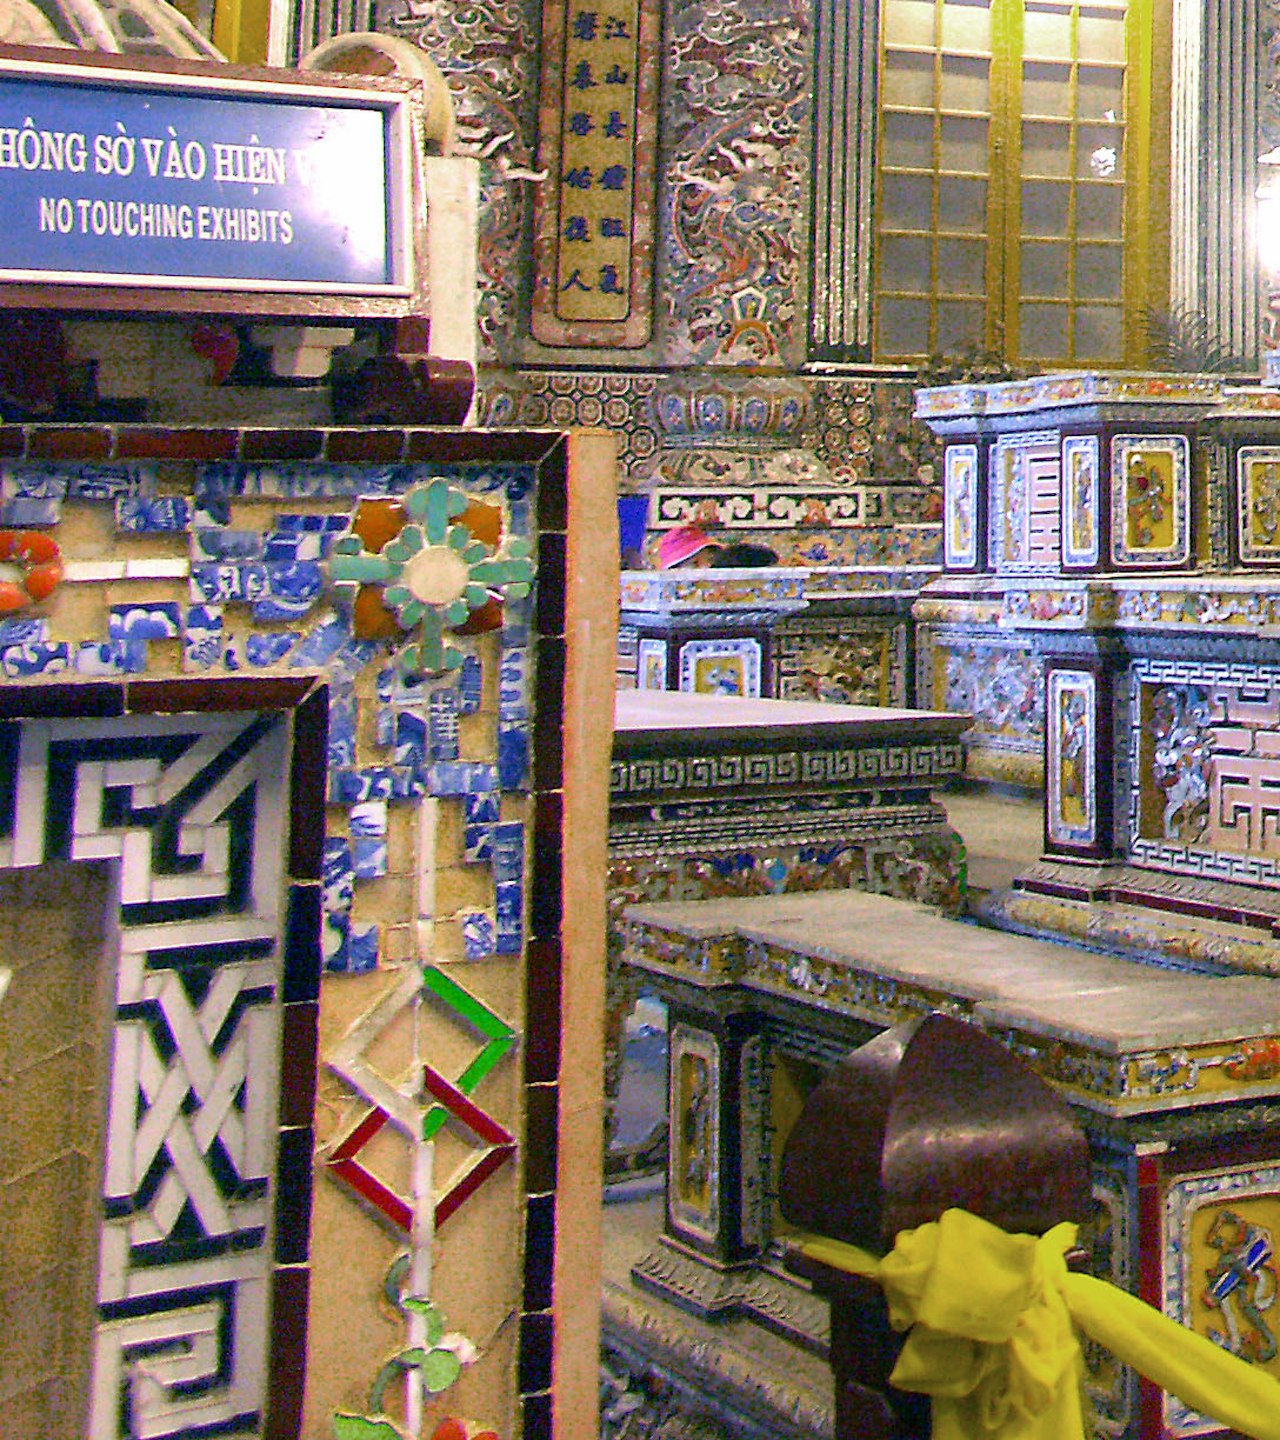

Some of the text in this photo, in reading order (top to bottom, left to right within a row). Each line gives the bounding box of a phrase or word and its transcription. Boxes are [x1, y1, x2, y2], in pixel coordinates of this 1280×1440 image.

[142, 126, 206, 181] VÀO
[213, 134, 287, 195] HIỆN
[39, 197, 293, 245] NO TOUCHING EXHIBITS
